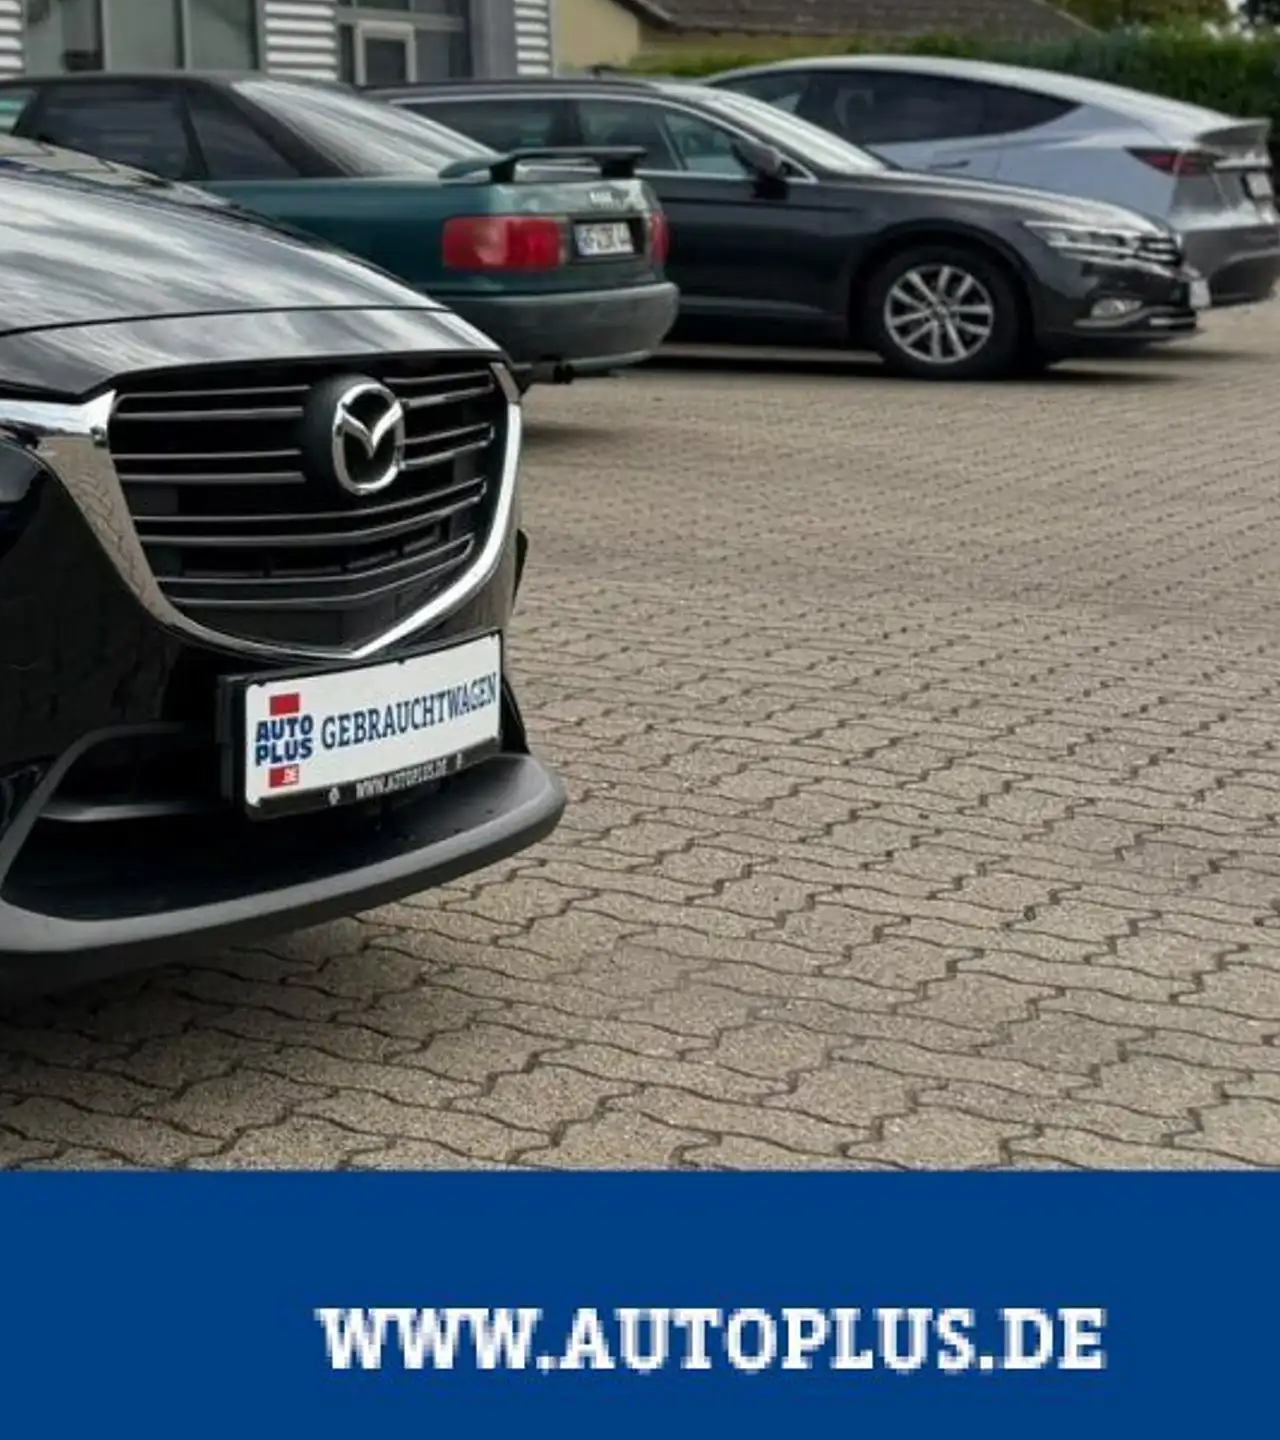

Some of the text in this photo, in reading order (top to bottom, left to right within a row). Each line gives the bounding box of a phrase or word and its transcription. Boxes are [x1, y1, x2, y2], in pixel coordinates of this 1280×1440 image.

[321, 672, 497, 750] GEBRAUCHTWAGEN
[255, 715, 314, 744] AUTO
[255, 738, 313, 766] PLUS
